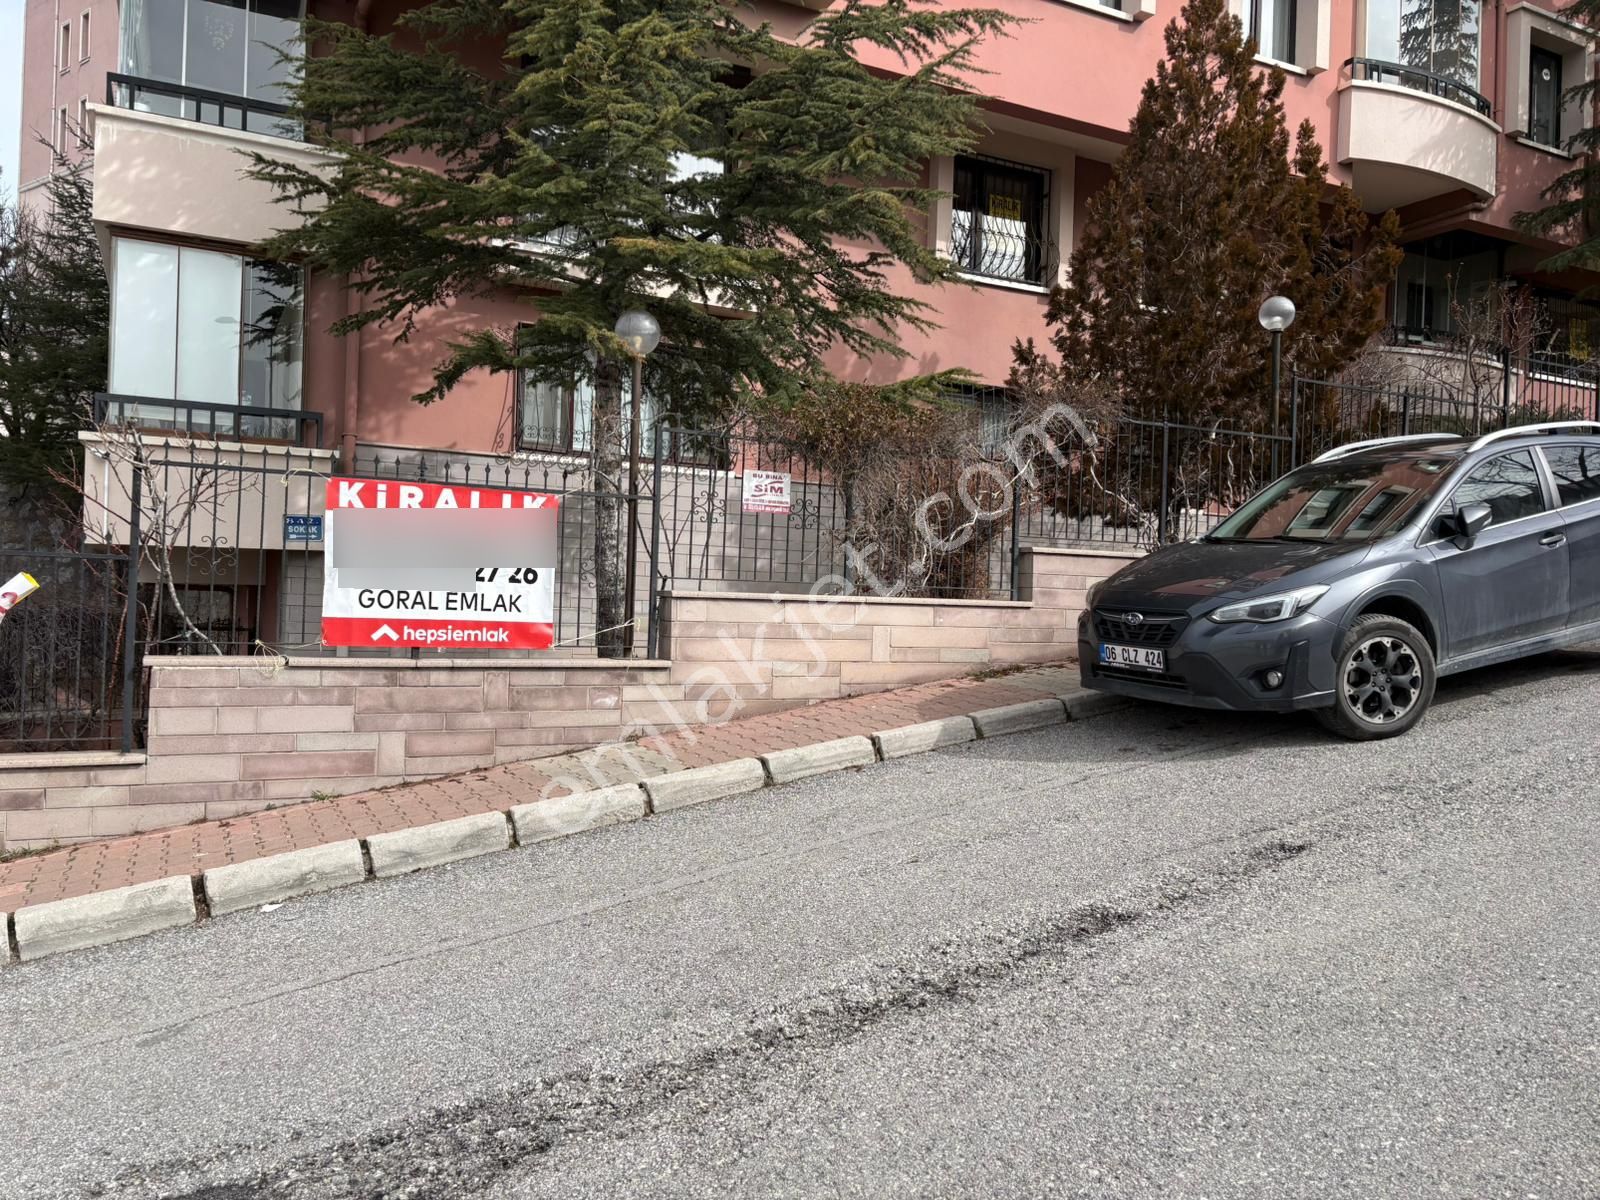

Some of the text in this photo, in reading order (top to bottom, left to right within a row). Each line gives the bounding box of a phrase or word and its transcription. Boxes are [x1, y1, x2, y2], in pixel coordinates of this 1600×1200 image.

[445, 592, 522, 613] EMLAK
[403, 625, 509, 644] hepsiemlak
[1105, 646, 1117, 661] 06
[1121, 647, 1140, 664] CLZ
[1145, 650, 1162, 667] 424
